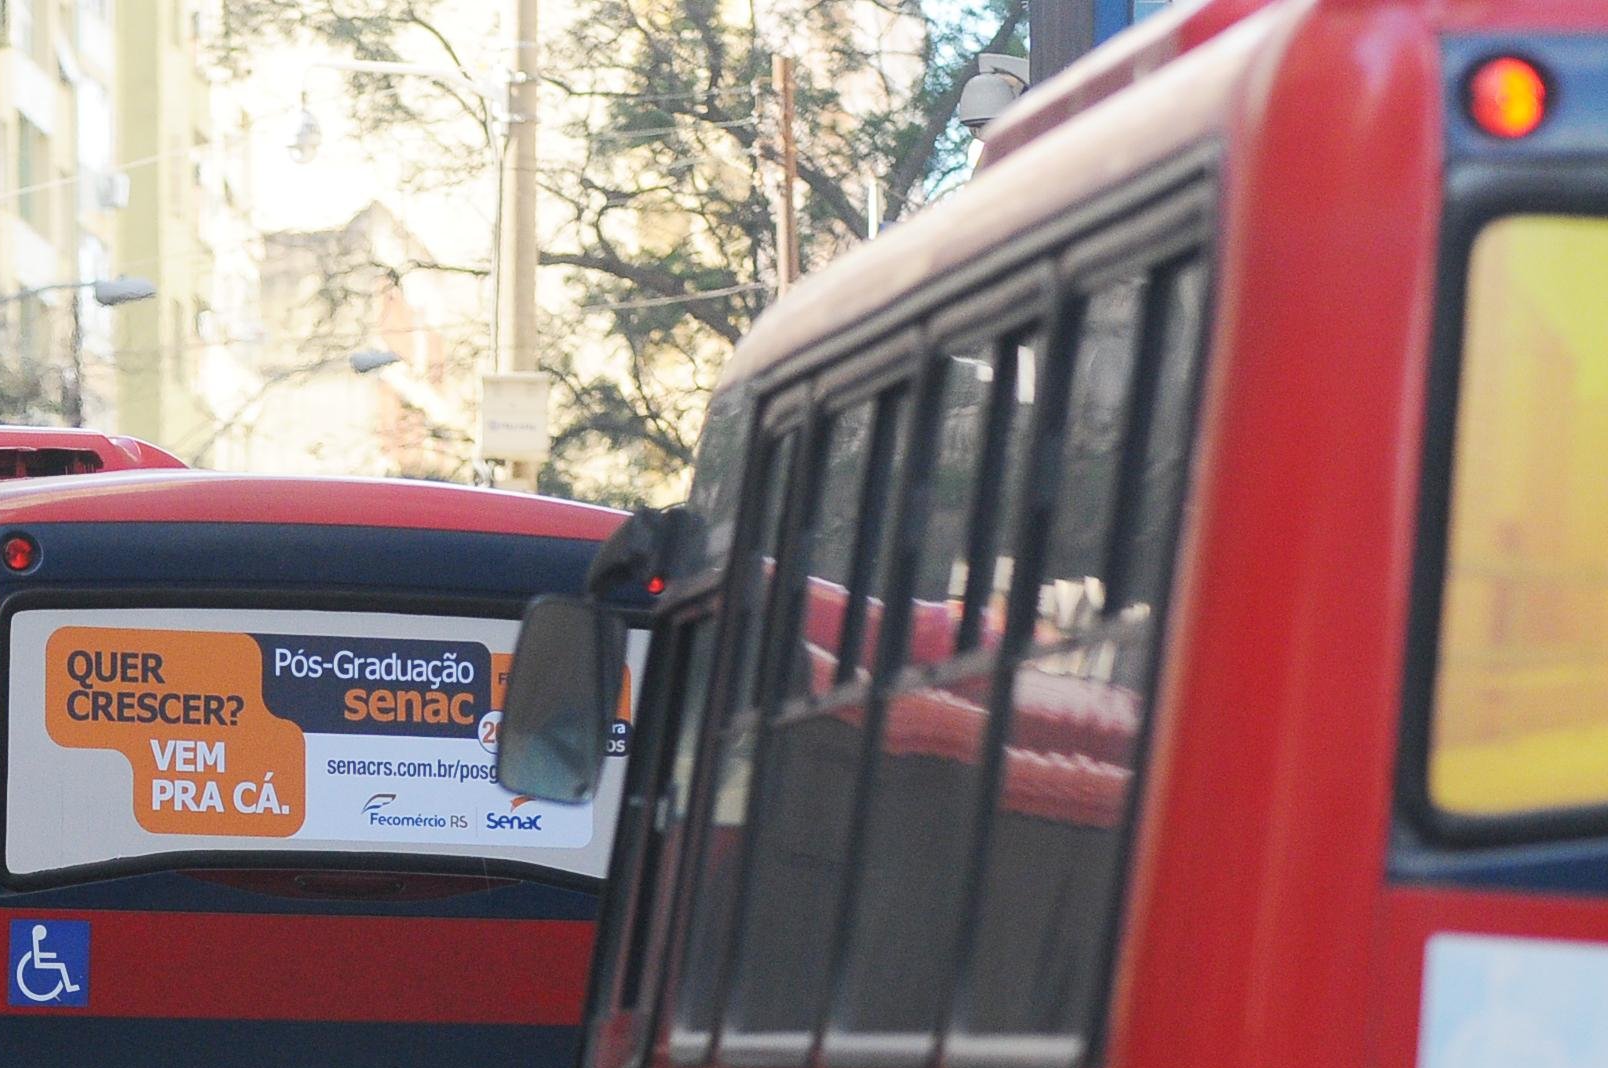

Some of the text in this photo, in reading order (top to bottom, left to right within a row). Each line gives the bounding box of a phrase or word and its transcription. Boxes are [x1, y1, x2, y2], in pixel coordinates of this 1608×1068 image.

[66, 650, 165, 689] QUER
[275, 648, 474, 689] Pós-Graduação
[66, 690, 244, 726] CRESCER?
[344, 688, 474, 725] senac
[149, 739, 226, 773] VEM
[151, 772, 290, 815] PRA CÁ.
[370, 812, 468, 828] Fecomércio RS
[486, 812, 542, 831] Senac
